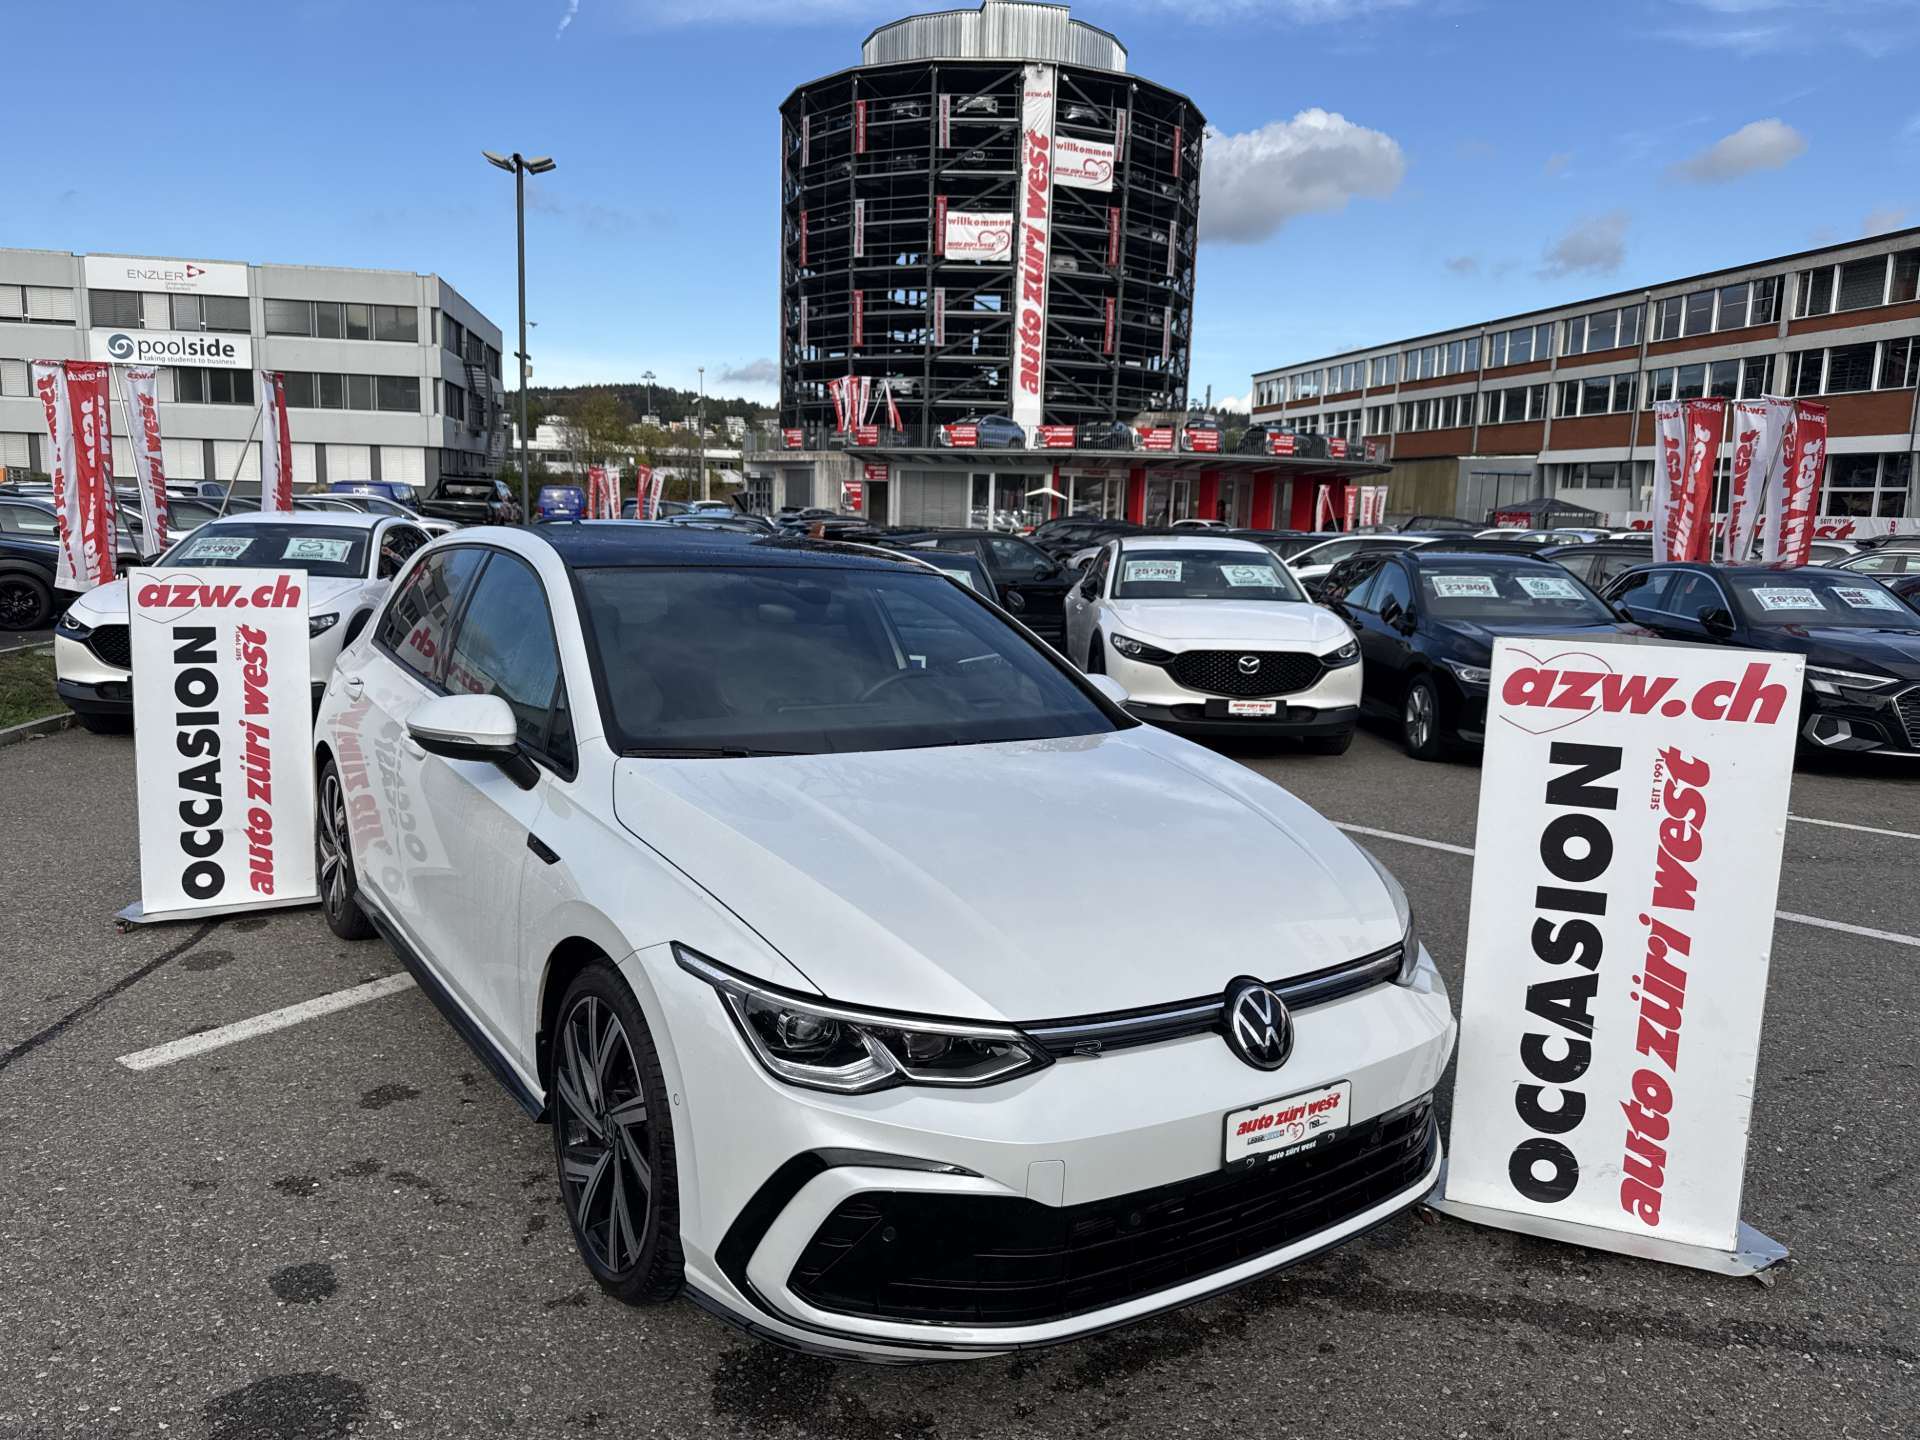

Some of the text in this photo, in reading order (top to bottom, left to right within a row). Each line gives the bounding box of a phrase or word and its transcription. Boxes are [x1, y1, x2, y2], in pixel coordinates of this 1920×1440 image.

[1056, 142, 1113, 157] willkommen
[948, 216, 1011, 226] willkommen
[127, 269, 184, 281] ENZLER
[1018, 128, 1049, 394] auto züri west
[138, 336, 235, 361] poolside
[167, 356, 196, 364] students
[207, 357, 236, 365] business
[137, 574, 301, 608] azw.ch
[1502, 662, 1787, 725] azw.ch
[173, 626, 225, 900] OCCASION
[236, 623, 274, 896] auto züri west
[1650, 757, 1665, 811] SEIT 1991
[1508, 741, 1623, 1204] OCCASION
[1620, 745, 1710, 1227] auto züri west
[1237, 1114, 1274, 1136] auto
[1275, 1101, 1308, 1126] züri
[1308, 1093, 1341, 1115] west
